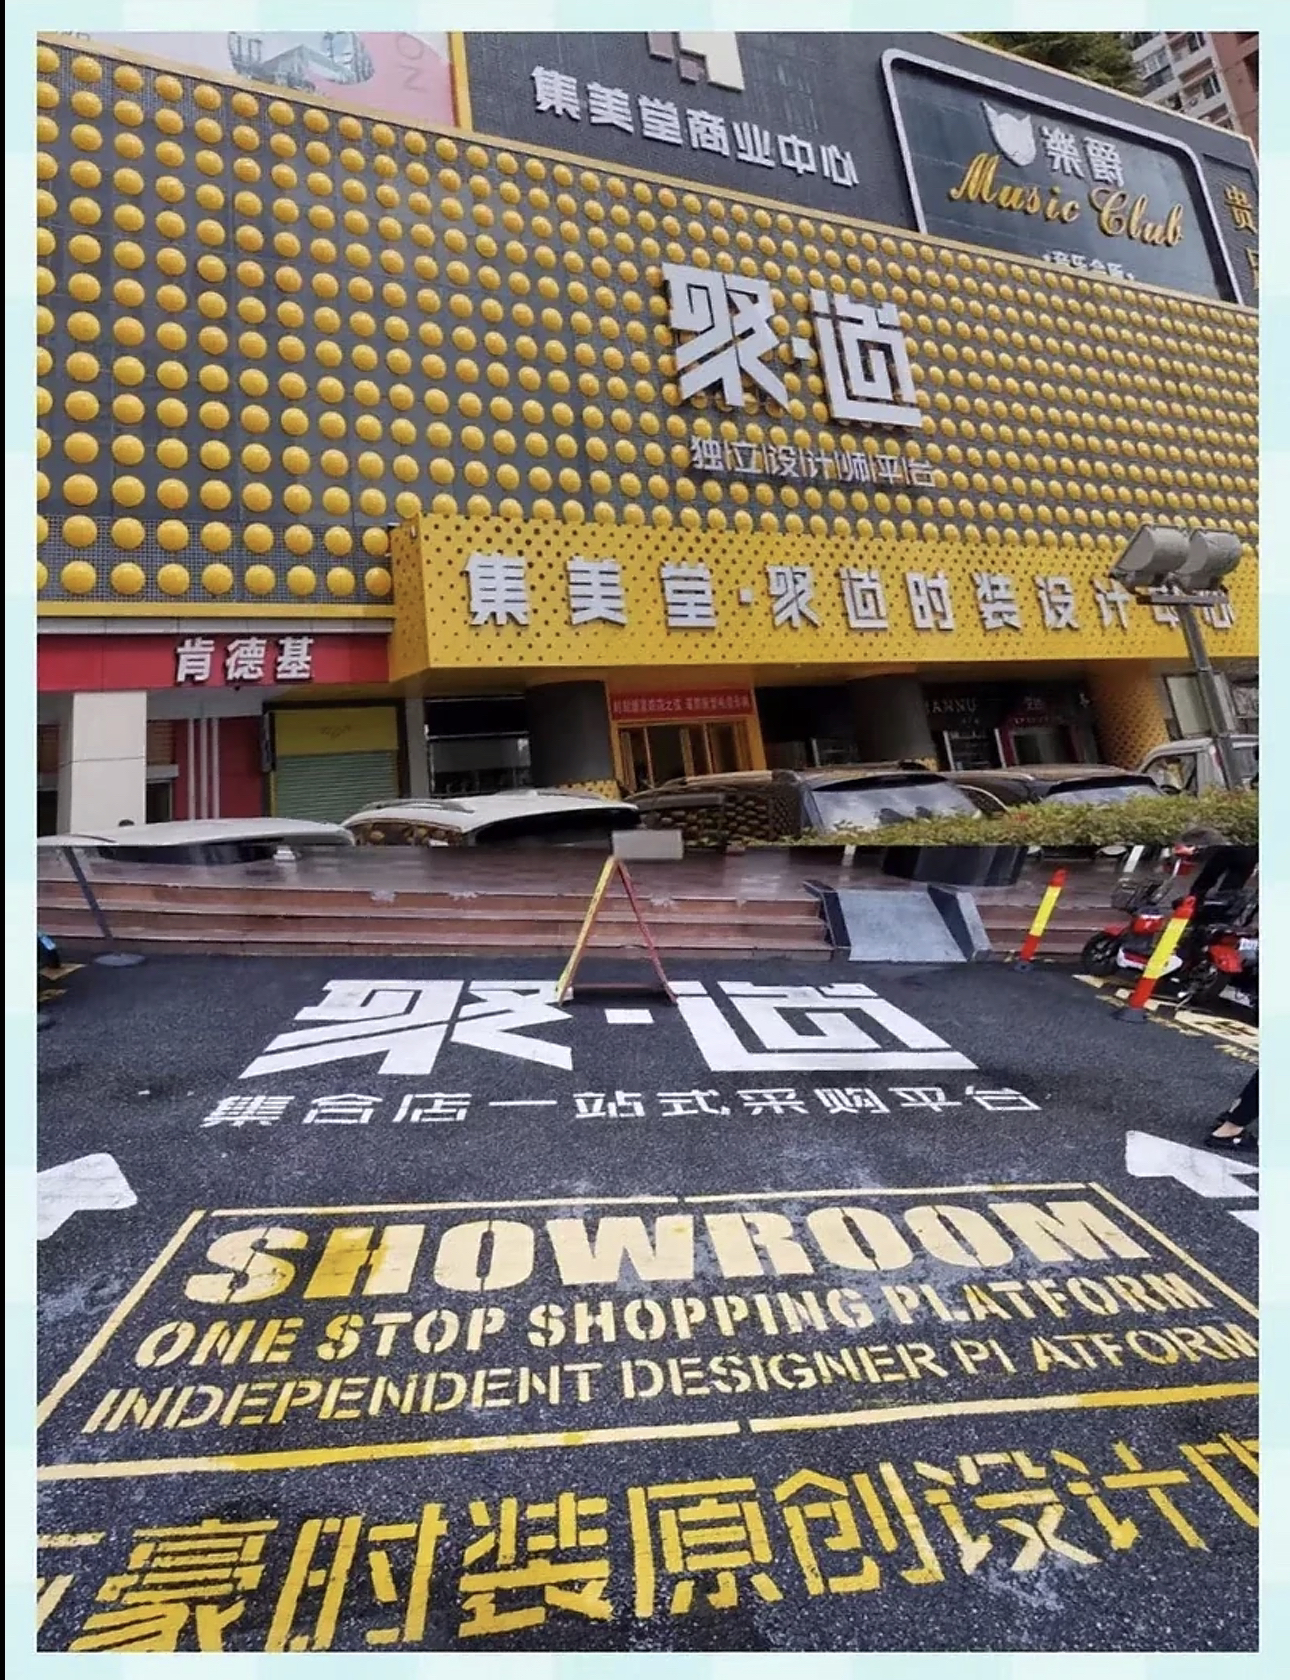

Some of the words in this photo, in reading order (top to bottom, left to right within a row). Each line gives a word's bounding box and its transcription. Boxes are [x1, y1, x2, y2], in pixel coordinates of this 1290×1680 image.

[531, 66, 859, 187] 集美堂商业中心
[949, 152, 1080, 224] Music
[1087, 187, 1184, 247] Club
[175, 636, 315, 683] 肯德基
[200, 1084, 1042, 1129] 集合店一站式采购平台
[183, 1200, 1151, 1304] SHOWROOM
[134, 1316, 304, 1369] ONE
[316, 1307, 506, 1361] STOP
[527, 1283, 875, 1349] SHOPPING
[893, 1270, 1214, 1325] PLATFORM
[81, 1361, 604, 1434] INDEPENDENT
[620, 1340, 950, 1400] DESIGNER
